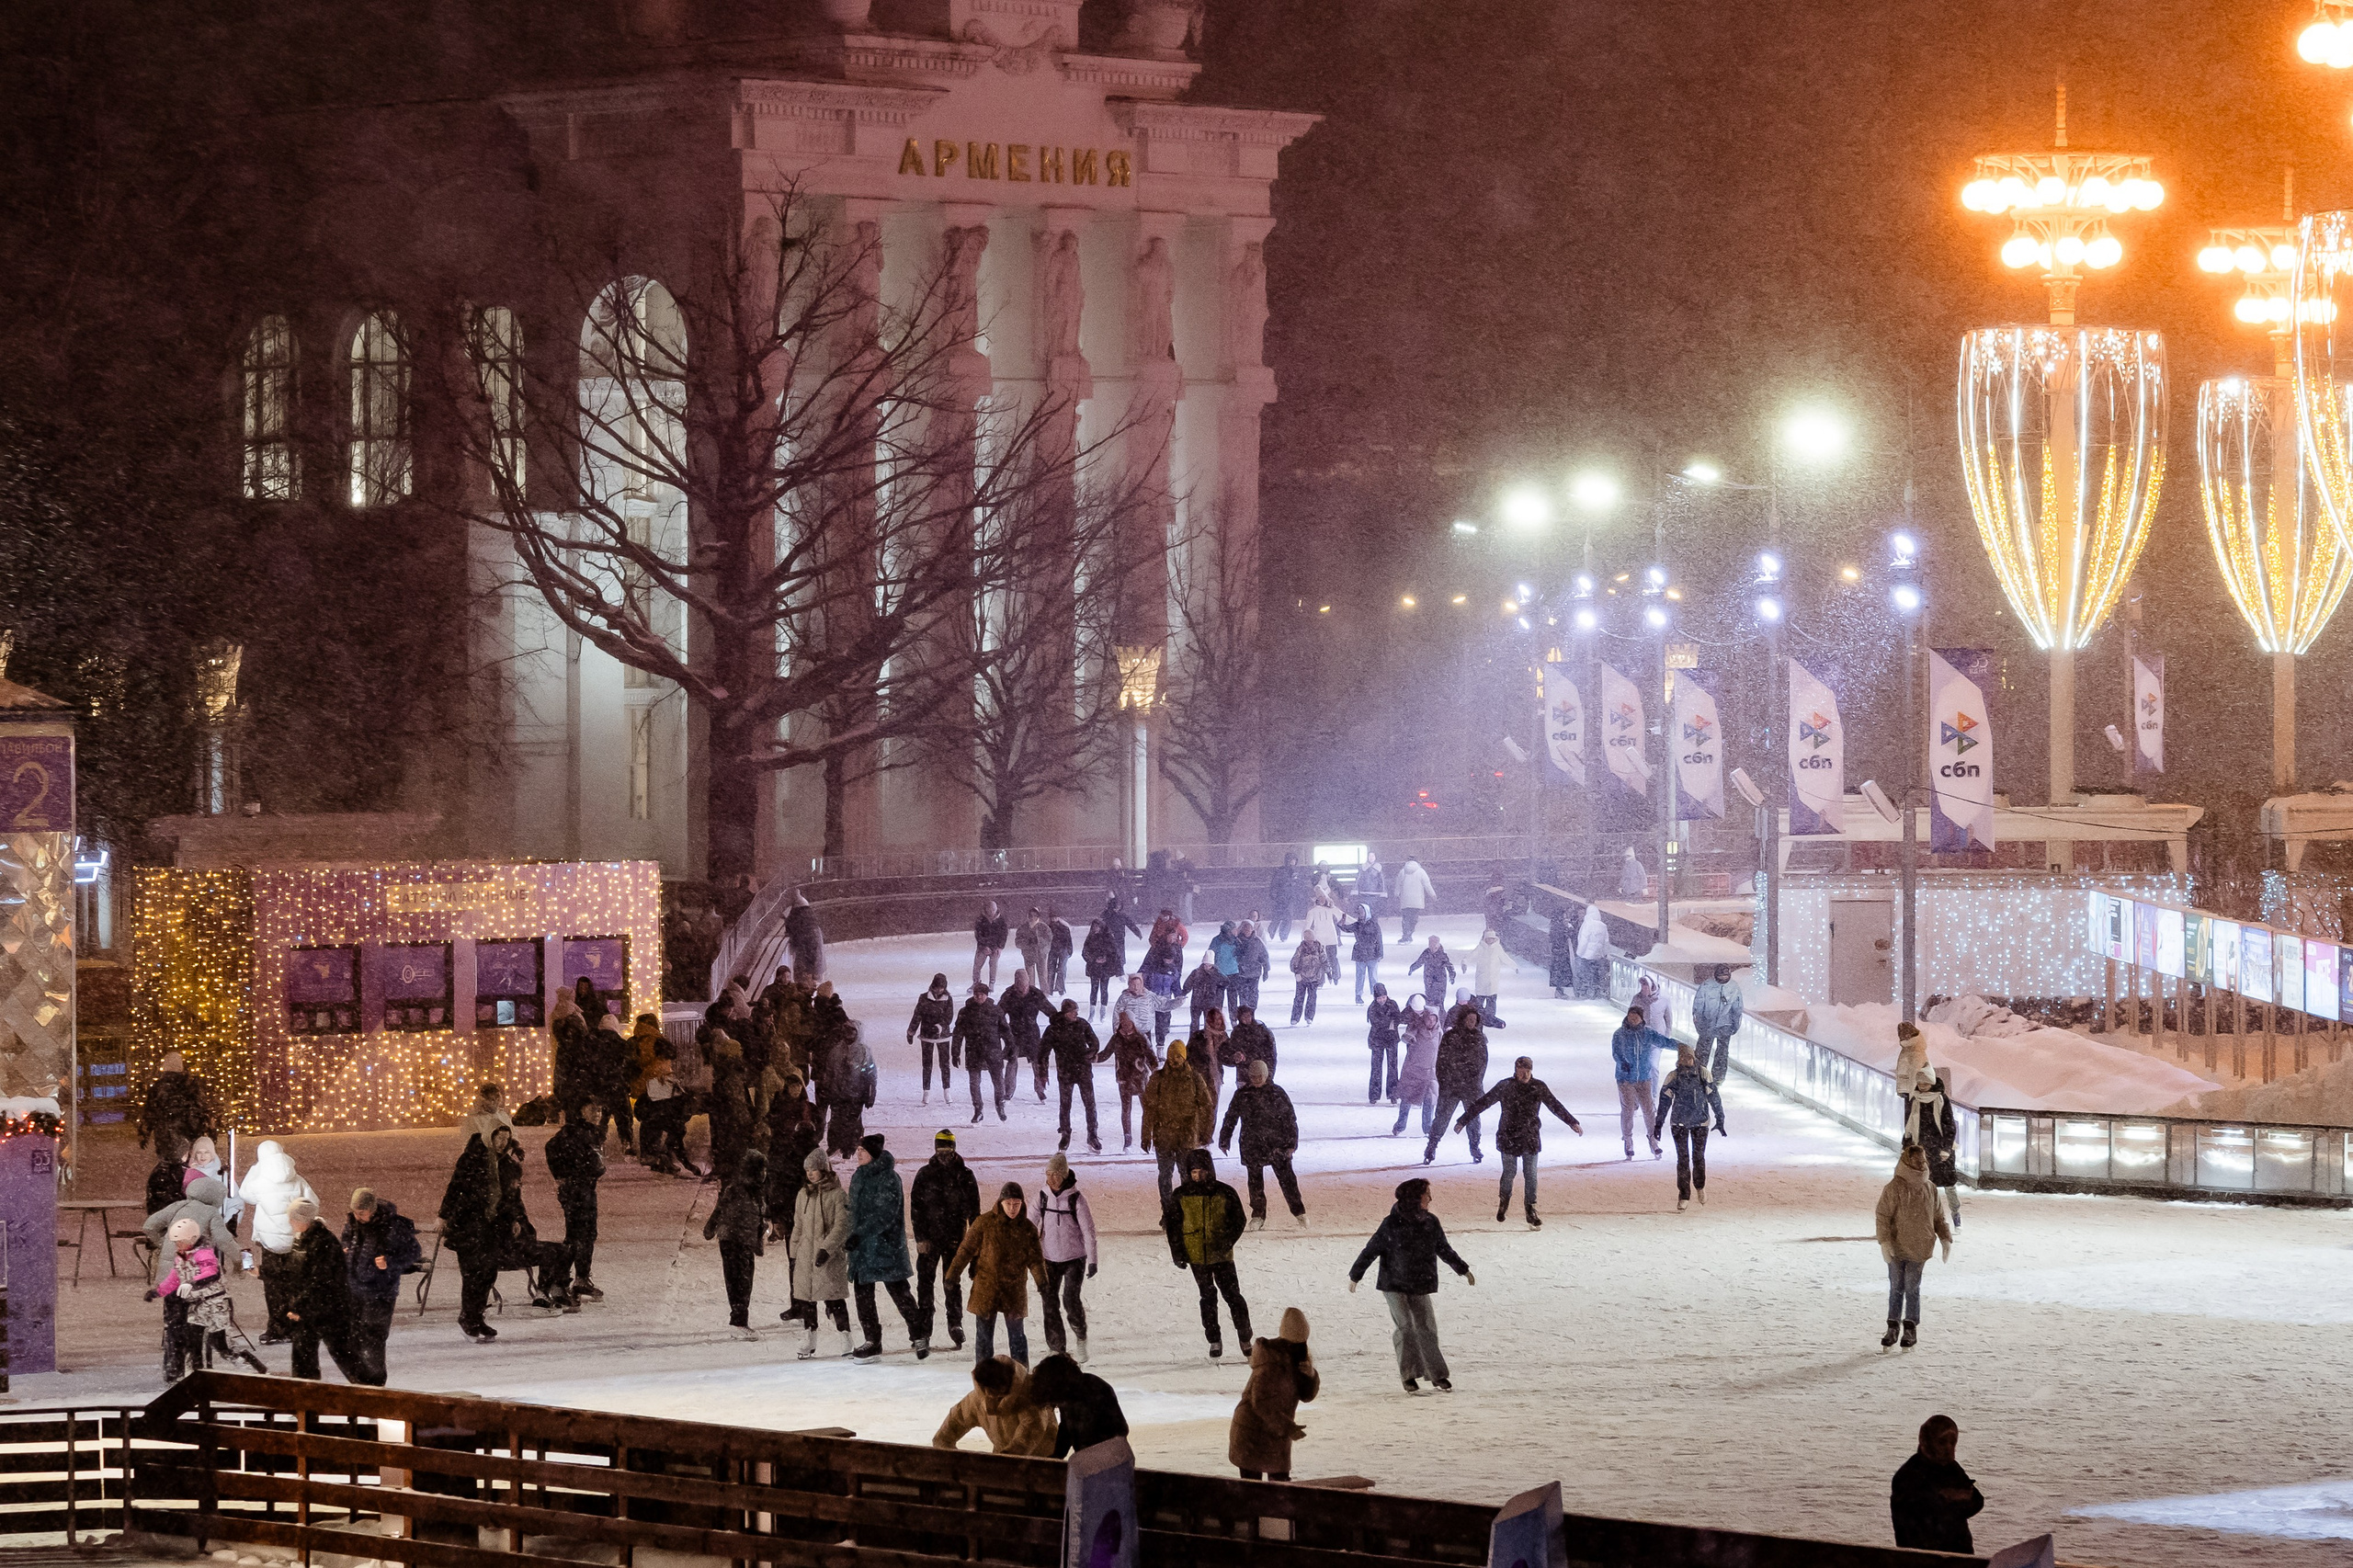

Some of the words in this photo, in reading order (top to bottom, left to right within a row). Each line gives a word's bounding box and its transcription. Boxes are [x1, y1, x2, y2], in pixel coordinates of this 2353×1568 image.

[898, 138, 1131, 187] АРМЕНИЯ
[1683, 751, 1713, 764] сбп
[1799, 755, 1833, 769] сбп
[1940, 761, 1980, 778] сбп
[13, 761, 50, 826] 2
